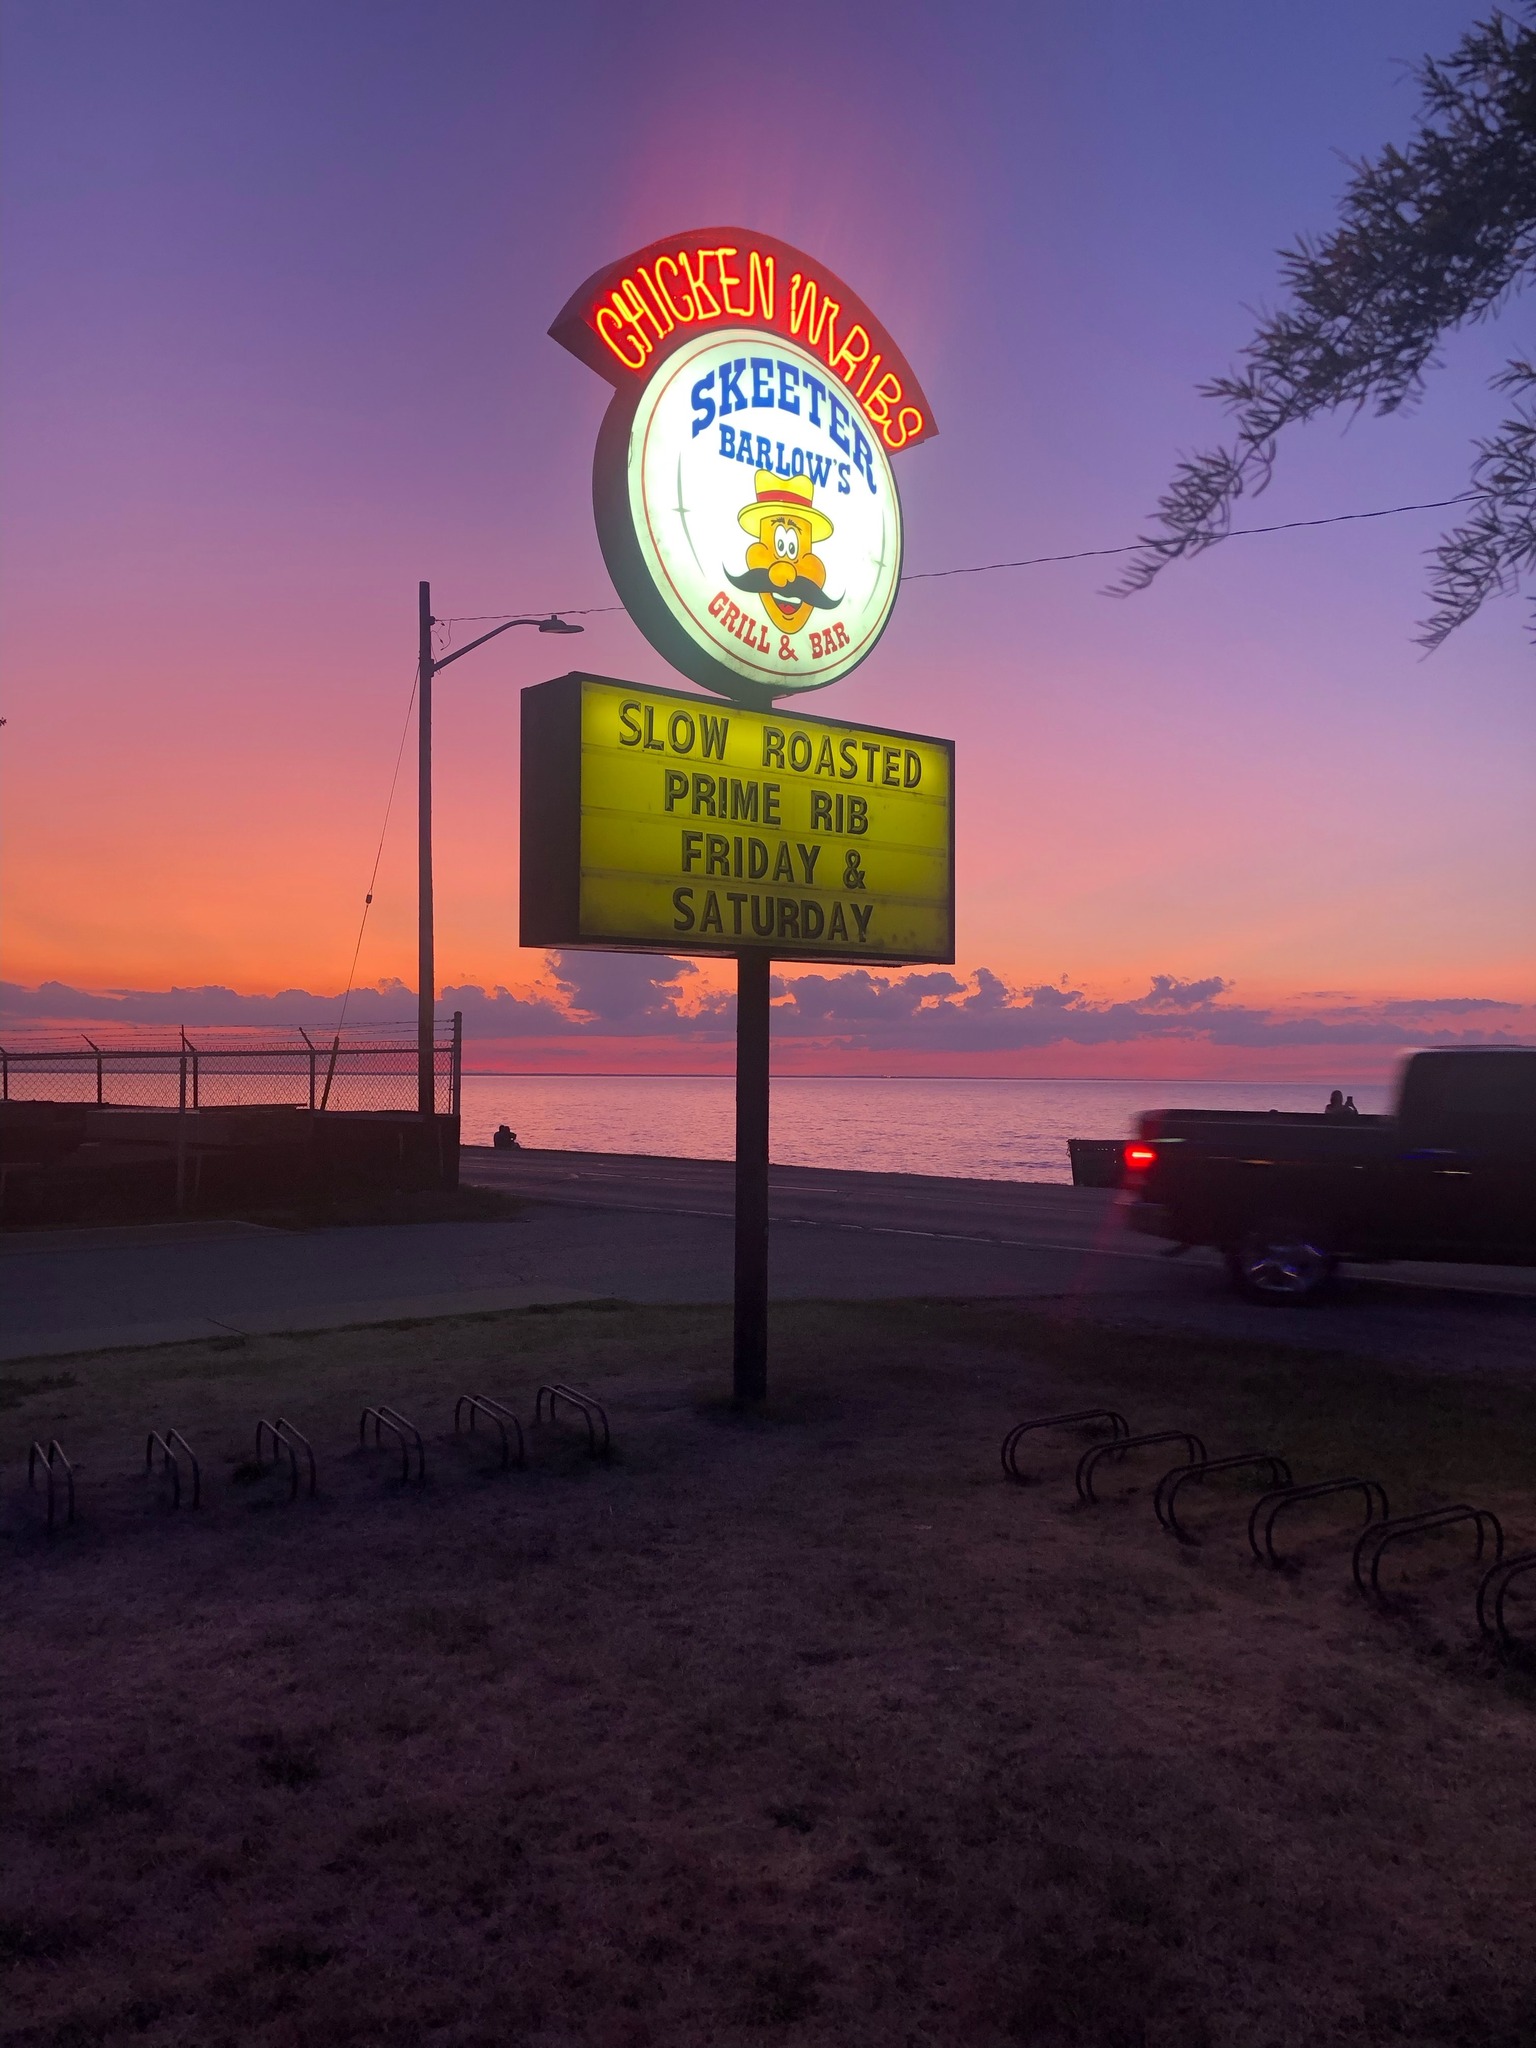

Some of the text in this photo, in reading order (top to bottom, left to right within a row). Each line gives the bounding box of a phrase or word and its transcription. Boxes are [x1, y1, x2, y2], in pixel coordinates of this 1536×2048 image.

[595, 247, 774, 369] CHICKEN
[690, 356, 877, 495] SKEETER
[718, 422, 851, 495] BARLOW'S
[707, 590, 850, 662] GRILL & BAR
[617, 699, 923, 789] SLOW ROASTED
[664, 769, 869, 836] PRIME RIB
[681, 829, 866, 890] FRIDAY &
[672, 886, 874, 943] SATURDAY
